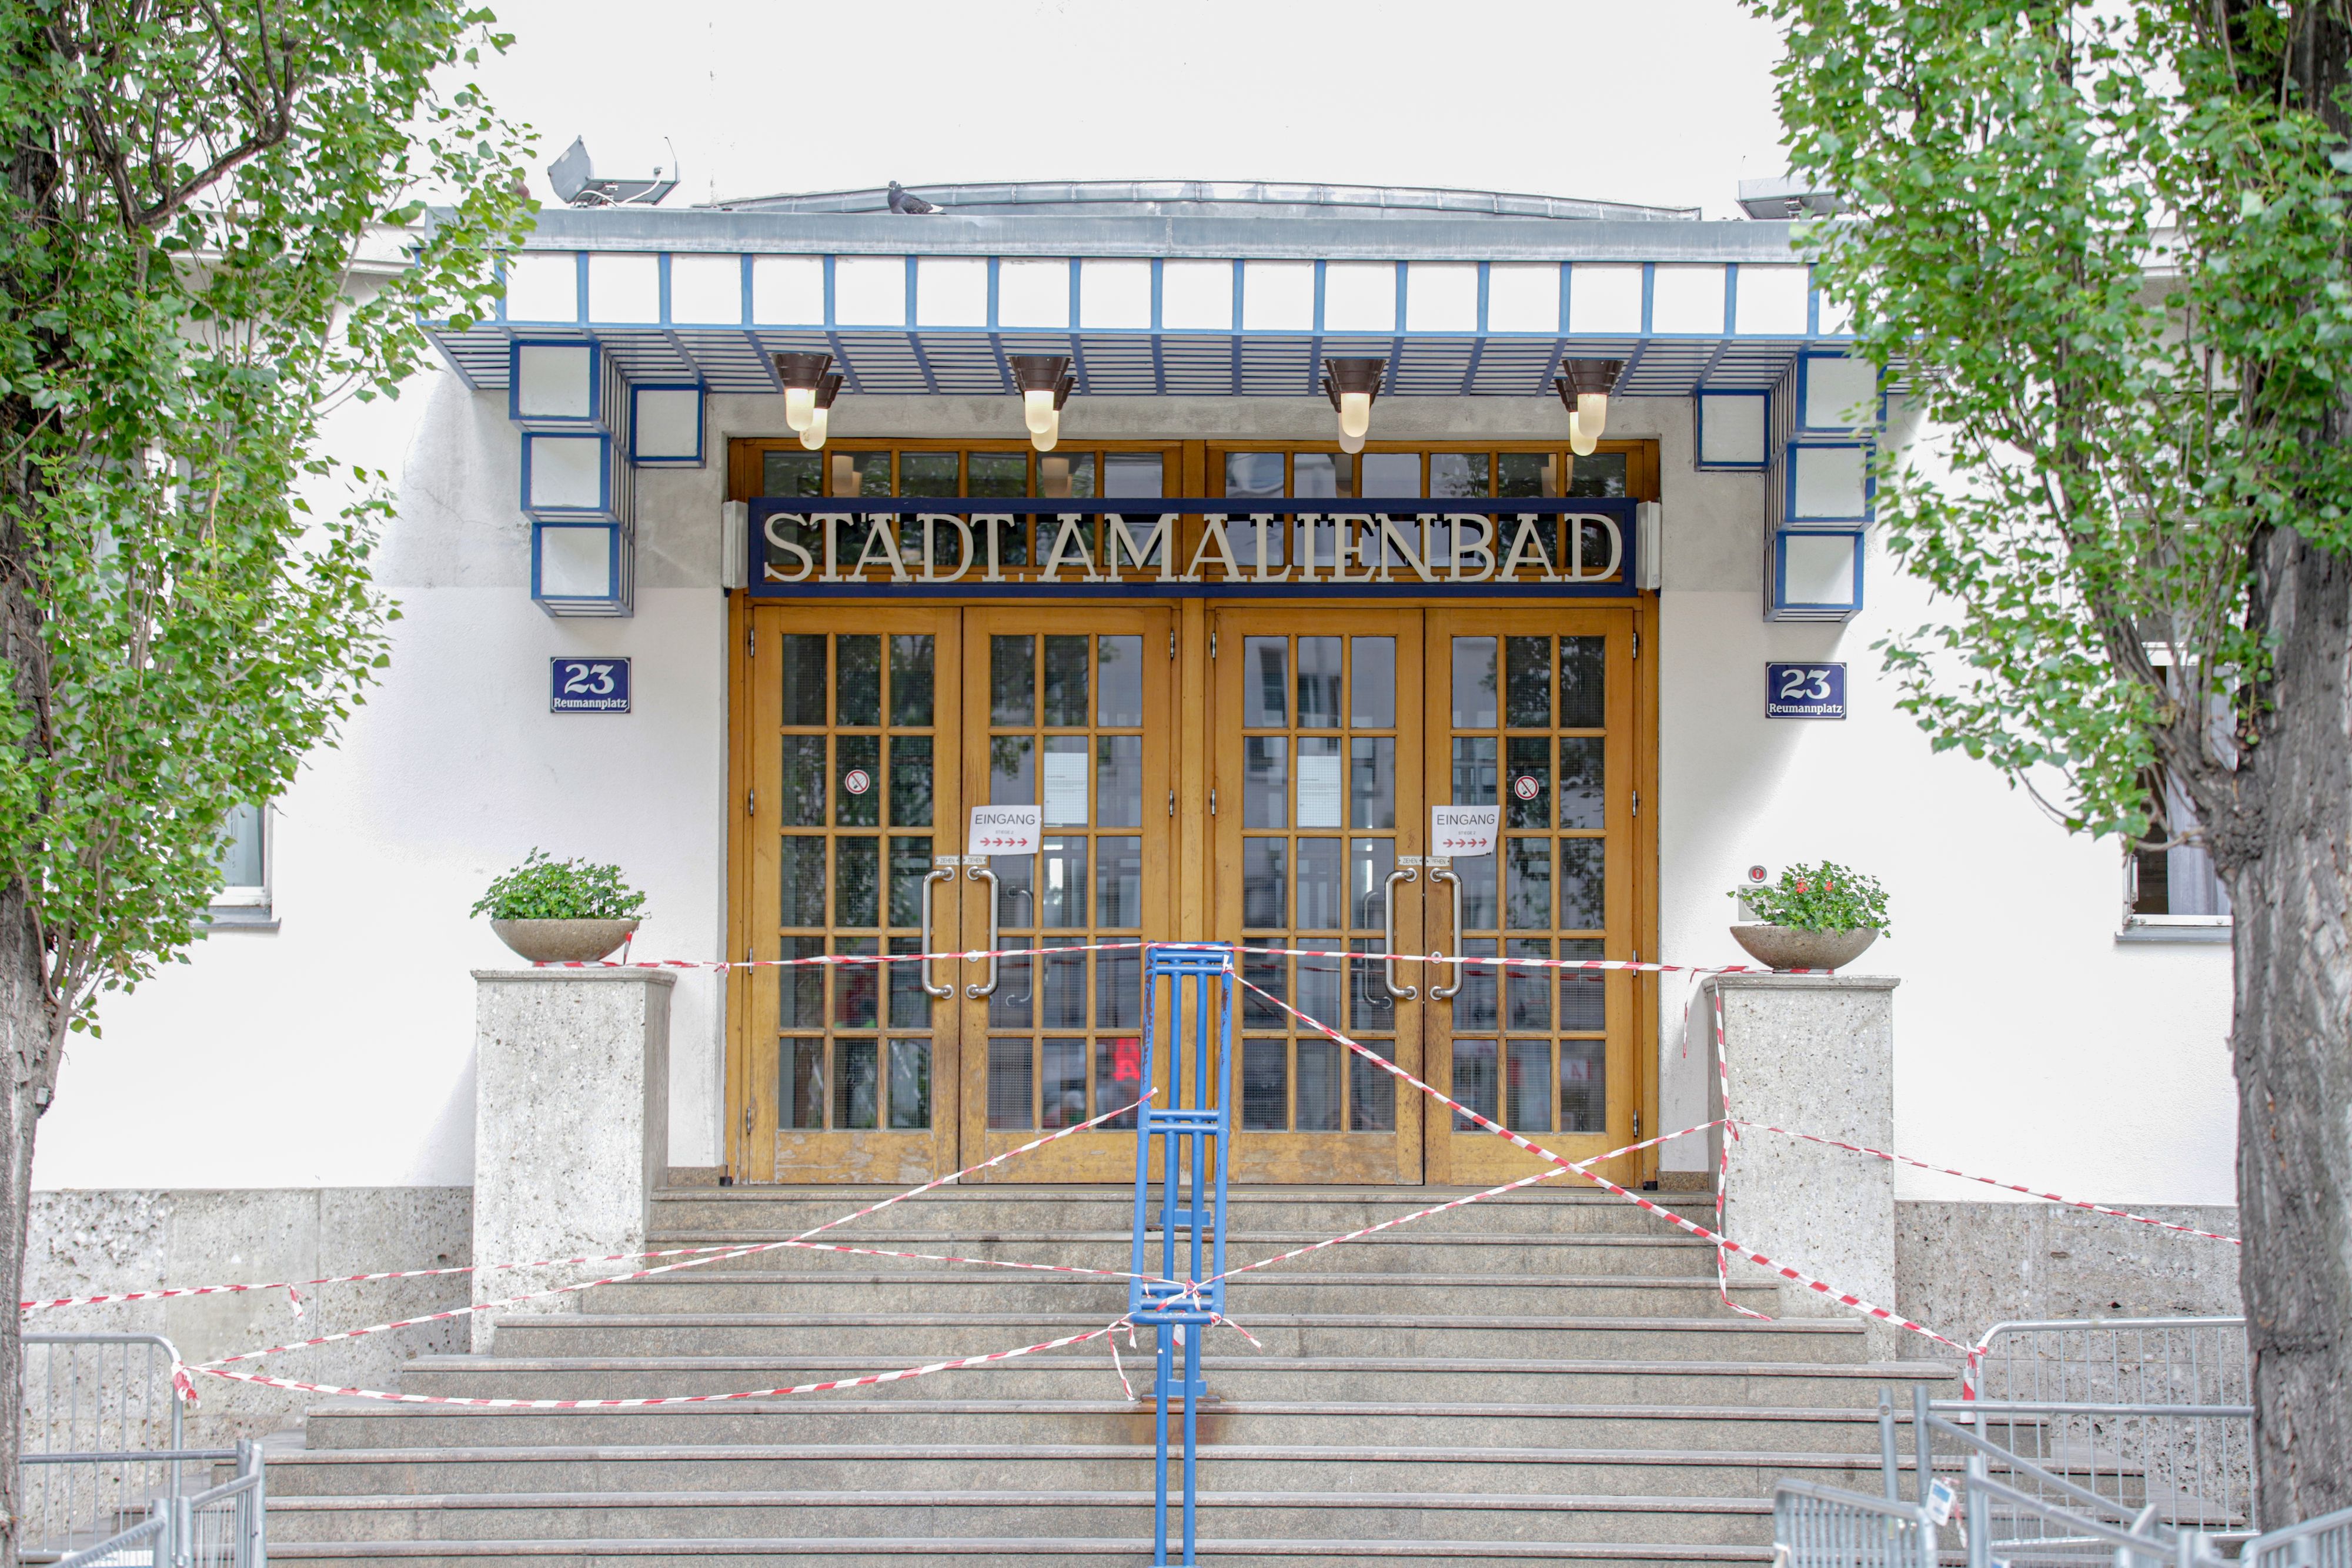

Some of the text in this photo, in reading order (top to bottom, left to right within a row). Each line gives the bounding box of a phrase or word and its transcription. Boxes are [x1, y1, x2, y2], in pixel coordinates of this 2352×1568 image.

[1037, 512, 1622, 583] AMALIENBAD
[564, 663, 614, 694] 23
[1780, 669, 1831, 700] 23
[553, 697, 627, 710] Reumannplatz
[1769, 703, 1843, 715] Reumannplatz
[975, 814, 1035, 825] EINGANG
[1436, 814, 1495, 825] EINGANG
